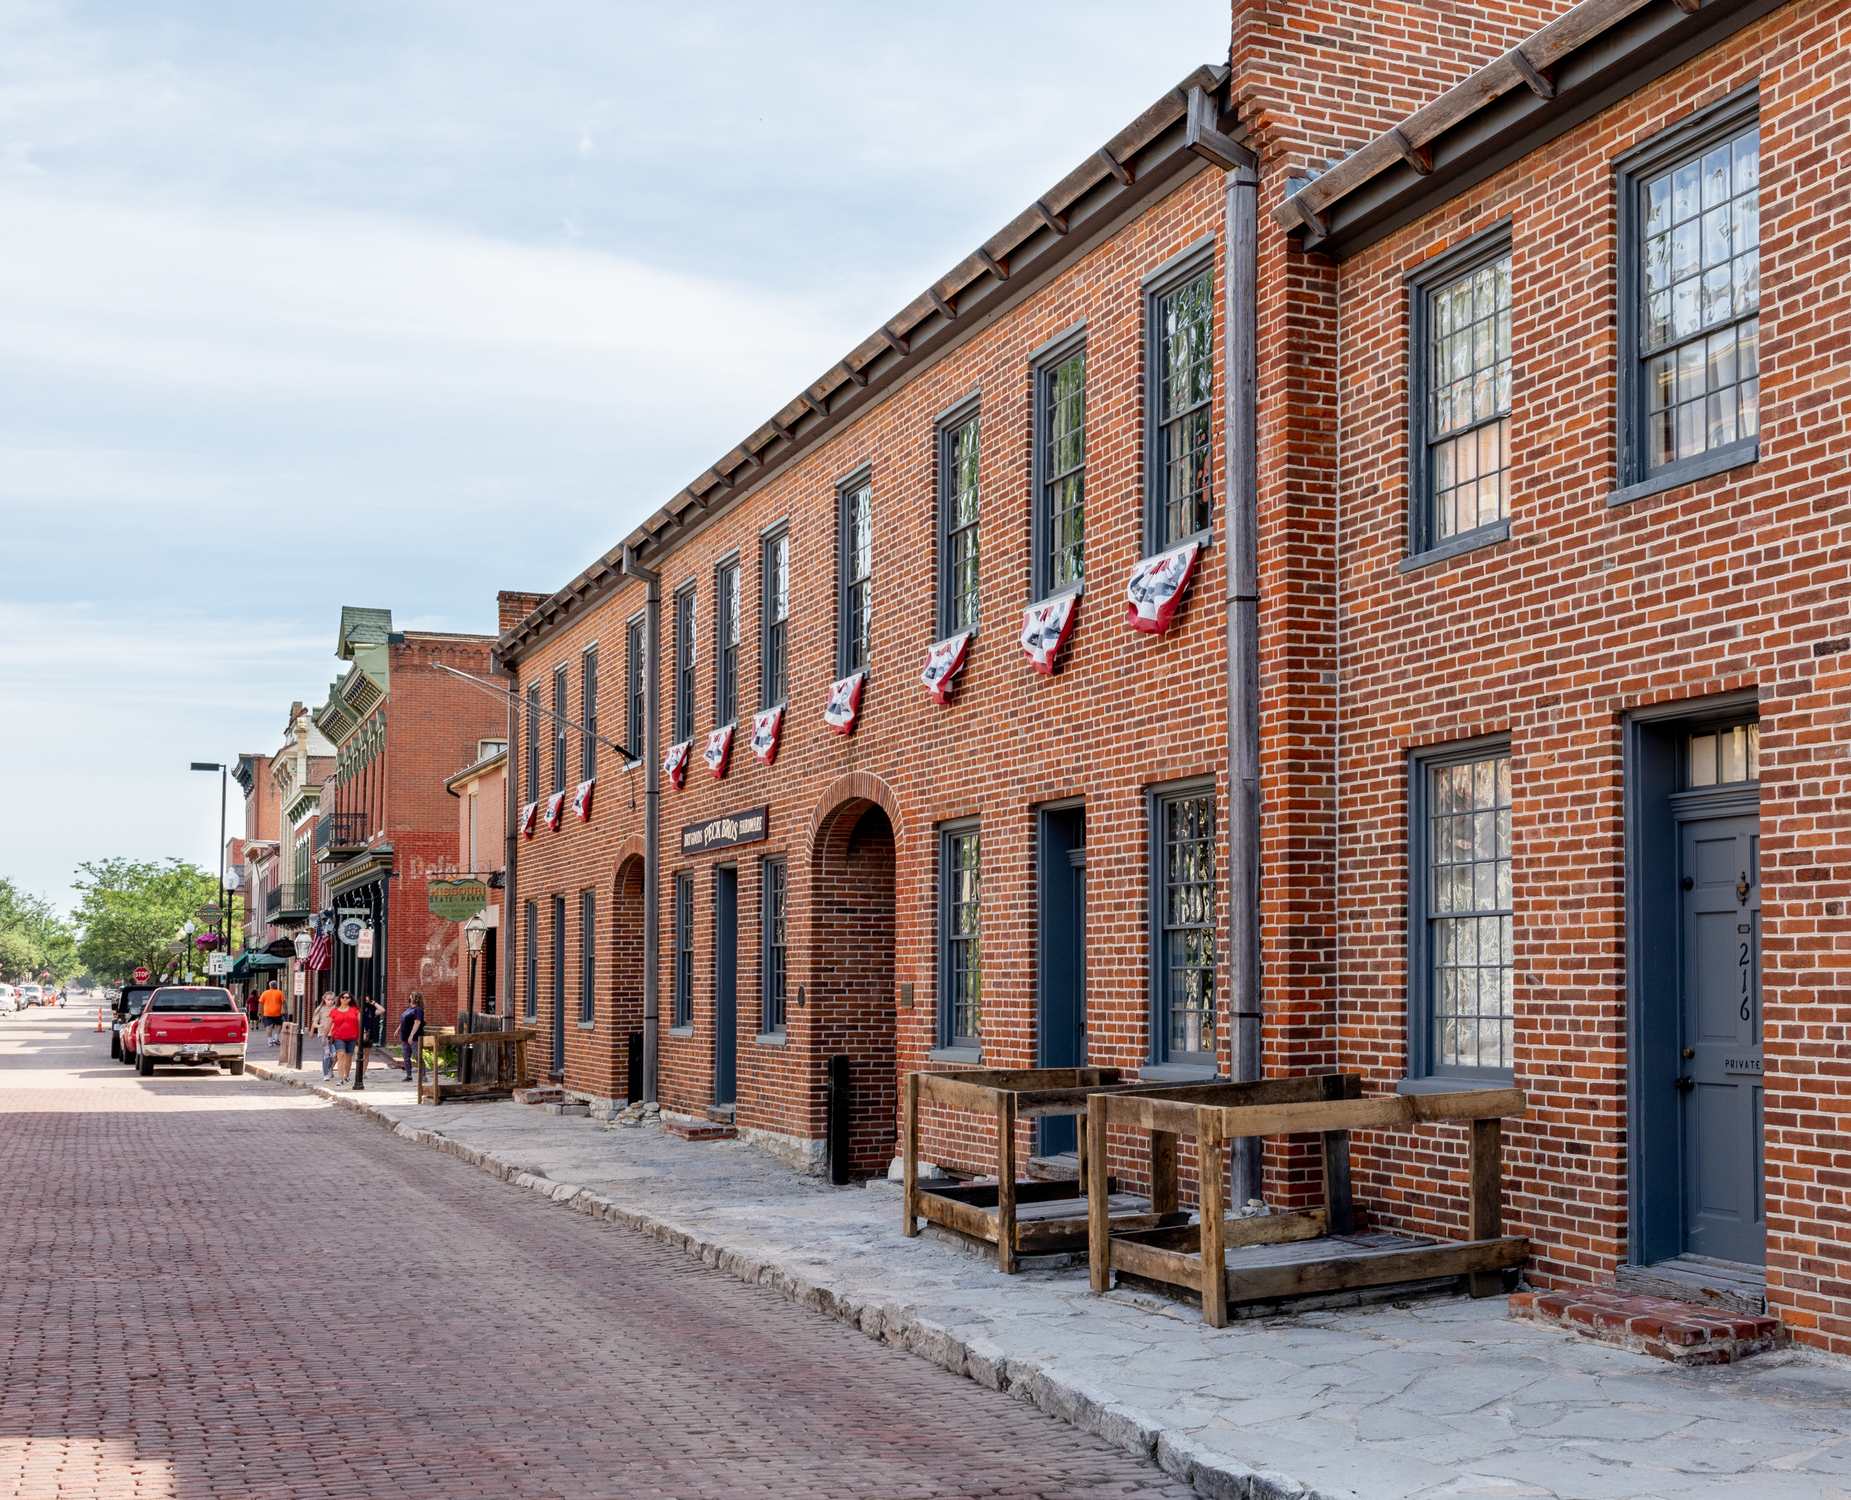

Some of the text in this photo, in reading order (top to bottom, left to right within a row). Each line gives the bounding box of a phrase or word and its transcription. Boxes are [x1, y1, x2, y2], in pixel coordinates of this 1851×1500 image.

[704, 821, 721, 847] PECK
[721, 819, 738, 841] BROS
[431, 887, 486, 896] MISSOURI
[1739, 943, 1750, 1021] 216
[1725, 1060, 1761, 1070] PRIVATE
